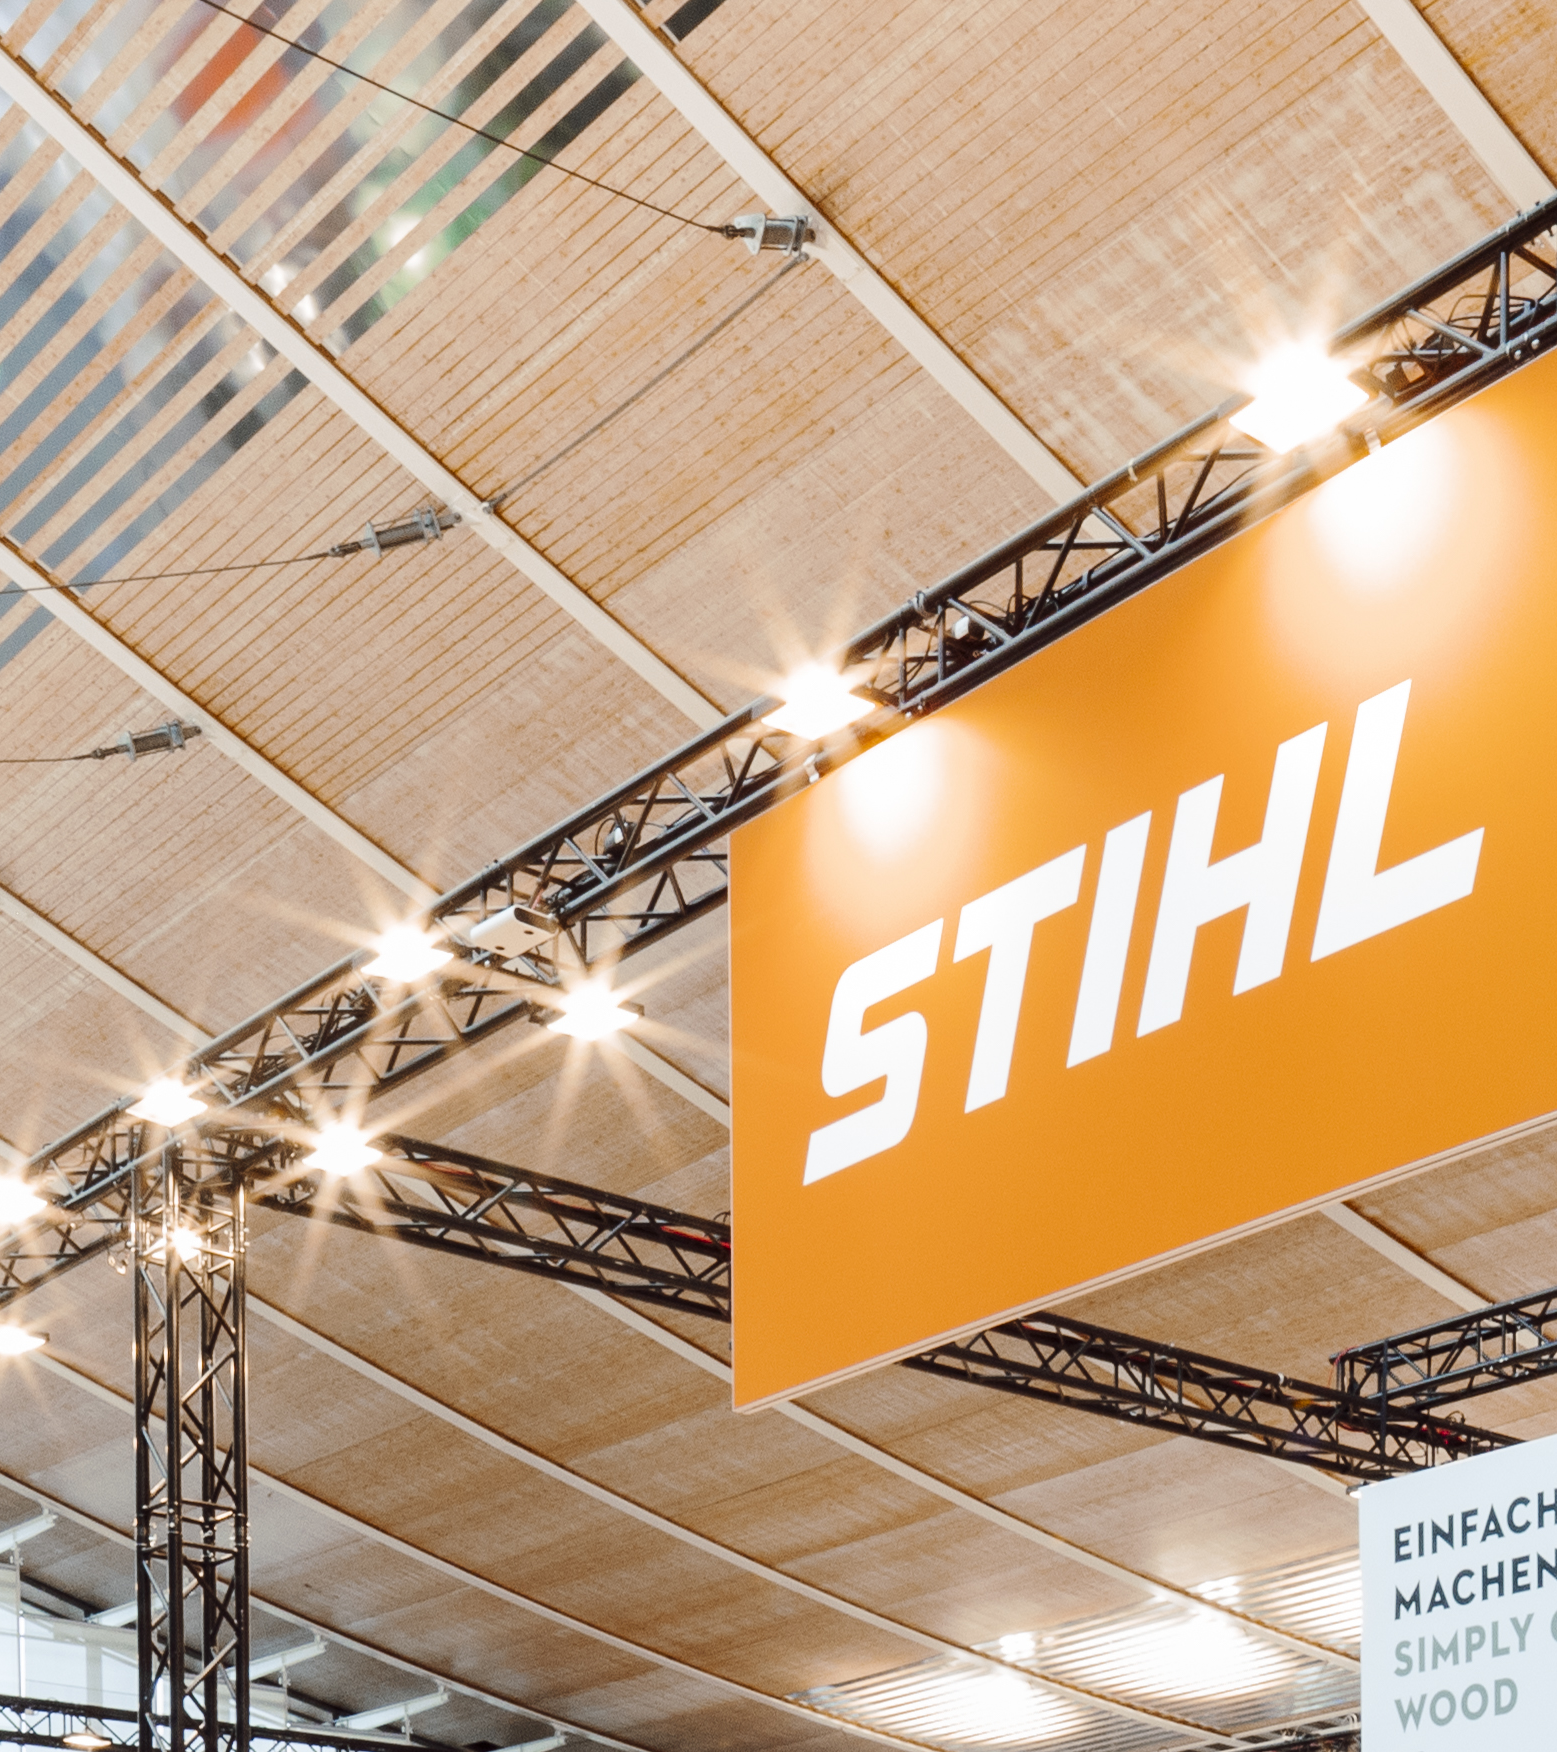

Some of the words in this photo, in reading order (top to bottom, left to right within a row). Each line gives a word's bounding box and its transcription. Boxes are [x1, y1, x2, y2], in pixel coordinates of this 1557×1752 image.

[803, 678, 1485, 1187] STIHL
[1394, 1612, 1535, 1677] SIMPLY
[1394, 1677, 1518, 1733] WOOD
